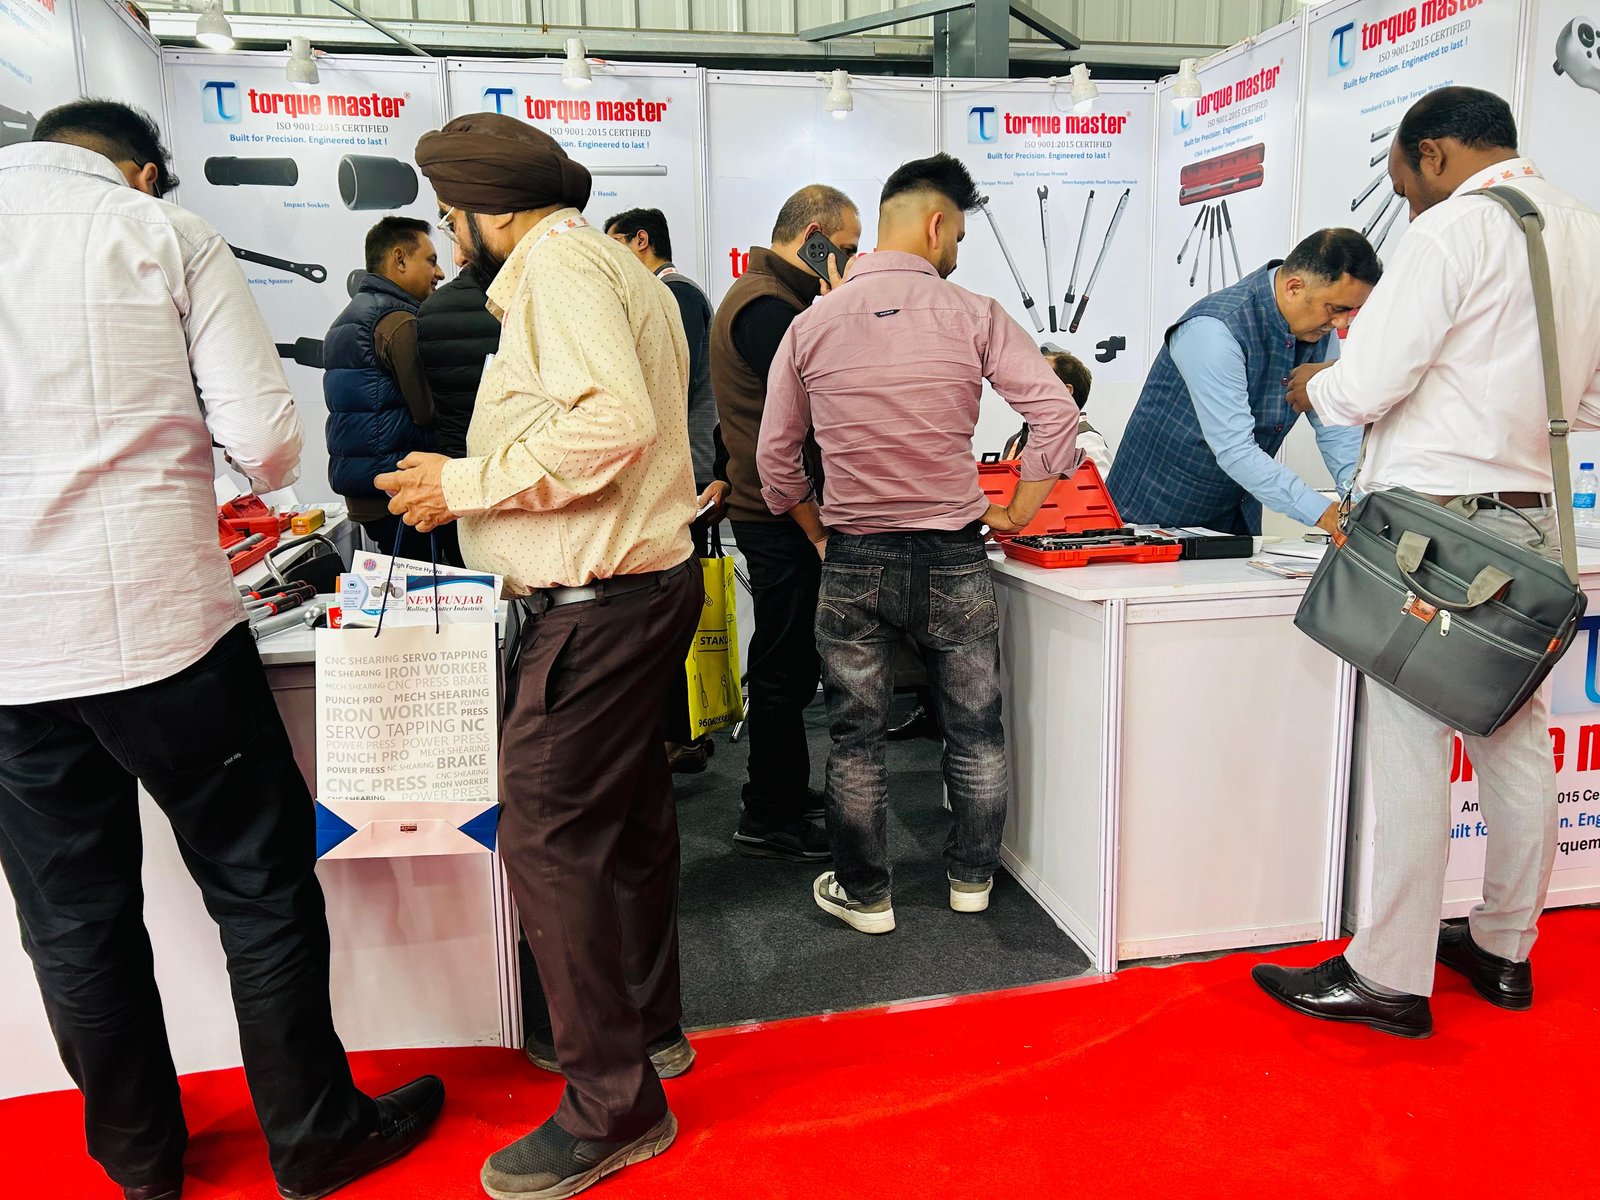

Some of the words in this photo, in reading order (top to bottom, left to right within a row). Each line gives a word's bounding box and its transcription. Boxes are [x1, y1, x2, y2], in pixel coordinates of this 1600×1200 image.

[1361, 6, 1417, 51] torque
[1378, 51, 1390, 63] ISO
[1391, 36, 1429, 59] 9001:2015
[1430, 19, 1471, 43] CERTIFIED
[1343, 78, 1358, 90] Built
[1359, 74, 1369, 85] for
[1370, 64, 1400, 81] Precision.
[1402, 49, 1440, 69] Engineered
[1441, 45, 1449, 55] to
[1450, 38, 1464, 52] last
[1235, 65, 1280, 102] master
[247, 88, 322, 118] torque
[327, 92, 406, 118] master
[524, 95, 591, 123] torque
[596, 98, 667, 122] master
[1360, 101, 1382, 115] Standard
[1382, 96, 1396, 109] Click
[1397, 92, 1409, 105] Type
[1410, 86, 1428, 99] Torque
[1207, 120, 1215, 128] ISO
[1241, 99, 1268, 116] CERTIFIED
[276, 122, 292, 131] ISO
[294, 122, 340, 132] 9001:2015
[342, 124, 389, 133] CERTIFIED
[549, 128, 563, 136] ISO
[565, 128, 607, 137] 9001:2015
[608, 128, 651, 137] CERTIFIED
[1004, 112, 1061, 137] torque
[1065, 112, 1127, 135] master
[1184, 139, 1194, 148] Built
[1222, 120, 1248, 135] Engineered
[1248, 118, 1254, 126] to
[1254, 114, 1263, 124] last
[230, 134, 249, 143] Built
[251, 134, 264, 143] for
[266, 134, 307, 143] Precision.
[309, 136, 355, 146] Engineered
[357, 137, 366, 145] to
[367, 136, 382, 146] last
[578, 141, 620, 149] Engineered
[632, 141, 645, 149] last
[1075, 140, 1112, 148] CERTIFIED
[1049, 152, 1085, 160] Engineered
[283, 201, 306, 210] Impact
[307, 201, 330, 209] Sockets
[407, 596, 434, 605] NEW
[437, 596, 483, 605] PUNJAB
[325, 656, 346, 665] CNC
[349, 654, 399, 665] SHEARING
[402, 652, 437, 663] SERVO
[440, 650, 488, 661] TAPPING
[338, 669, 381, 677] SHEARING
[385, 665, 420, 679] IRON
[425, 661, 488, 676] WORKER
[348, 682, 386, 691] SHEARING
[387, 679, 412, 691] CNC
[415, 676, 449, 689] PRESS
[453, 674, 489, 686] BRAKE
[325, 696, 360, 704] PUNCH
[363, 695, 383, 704] PRO
[393, 692, 426, 703] MECH
[430, 688, 489, 700] SHEARING
[326, 707, 373, 722] IRON
[379, 701, 458, 721] WORKER
[461, 707, 489, 716] PRESS
[326, 724, 381, 739] SERVO
[386, 718, 455, 738] TAPPING
[461, 718, 485, 732] NC
[326, 740, 363, 750] POWER
[366, 739, 396, 749] PRESS
[402, 735, 449, 749] POWER
[453, 732, 490, 745] PRESS
[327, 751, 377, 763] PUNCH
[381, 749, 409, 762] PRO
[420, 748, 445, 757] MECH
[447, 743, 490, 754] SHEARING
[327, 766, 358, 774] POWER
[359, 766, 385, 774] PRESS
[399, 761, 434, 771] SHEARING
[437, 753, 487, 770] BRAKE
[436, 772, 452, 780] CNC
[453, 768, 489, 779] SHEARING
[325, 778, 366, 793] CNC
[371, 775, 427, 792] PRESS
[432, 781, 453, 789] IRON
[454, 777, 489, 787] WORKER
[401, 789, 449, 801] POWER
[453, 785, 489, 798] PRESS
